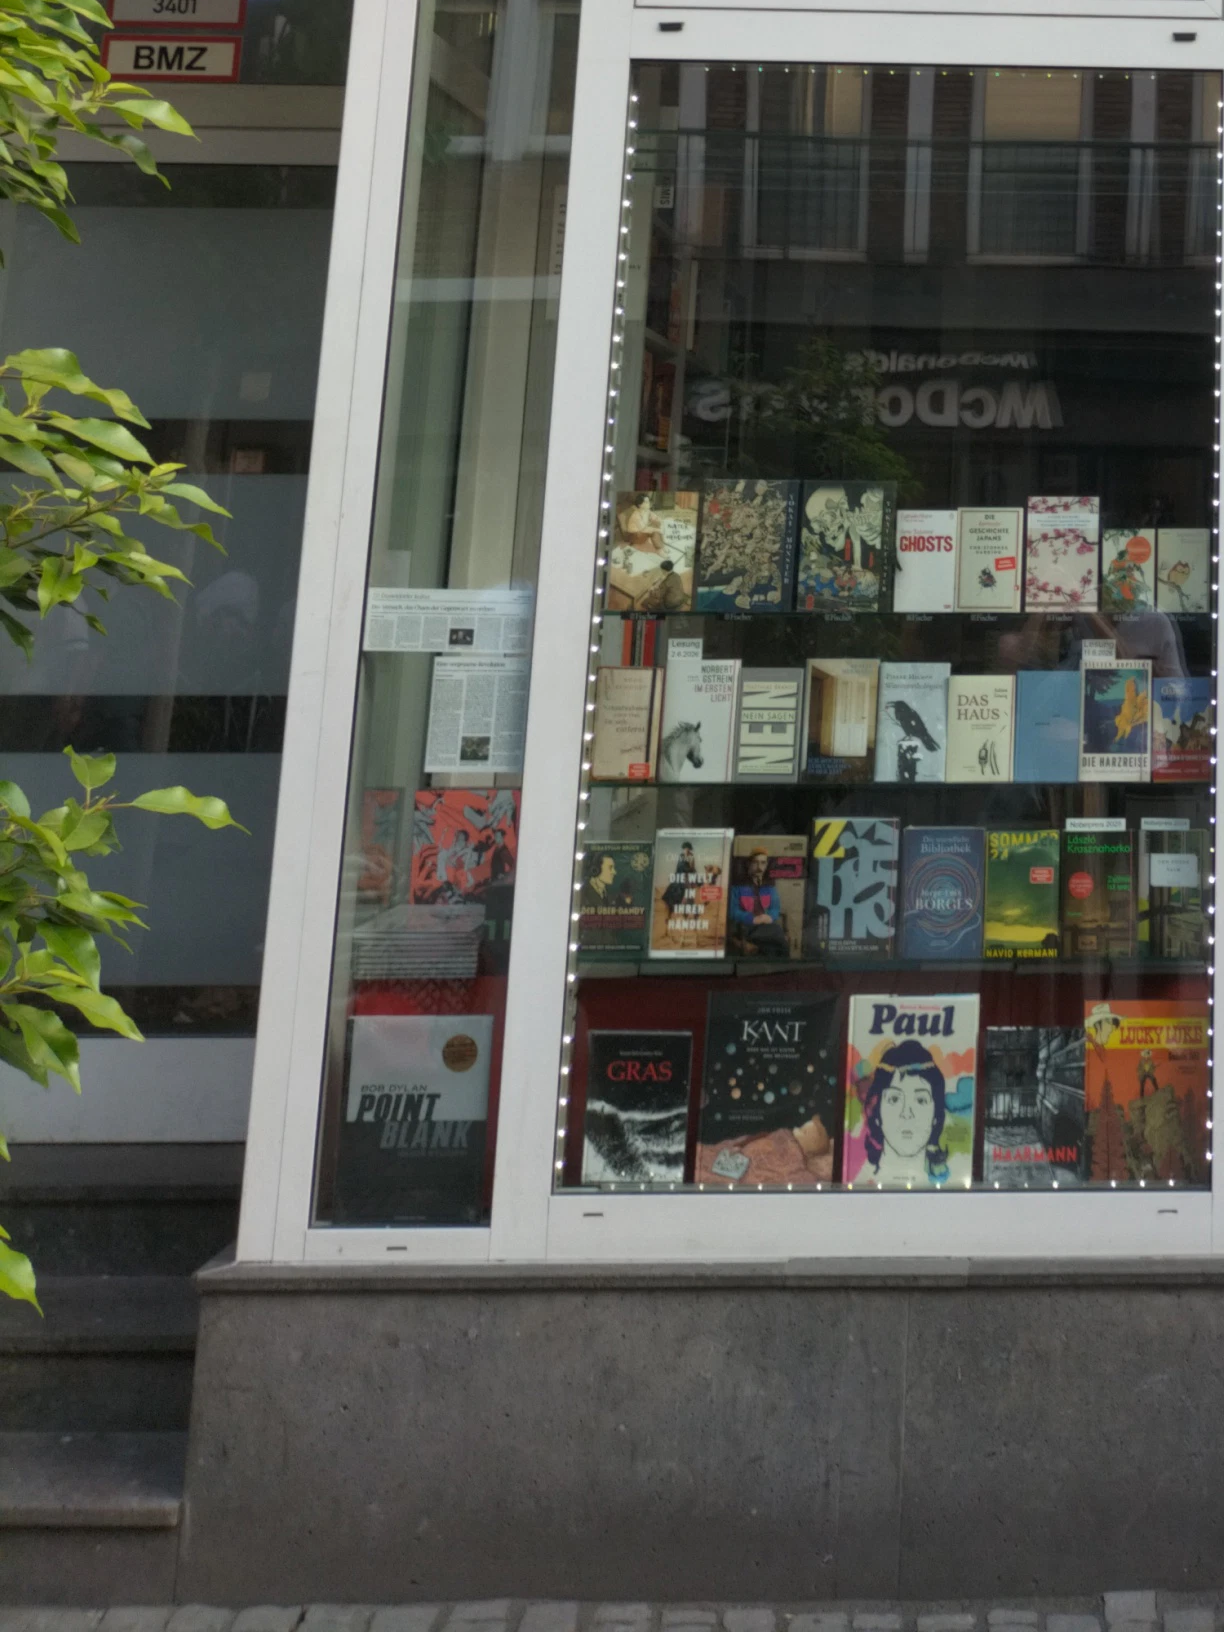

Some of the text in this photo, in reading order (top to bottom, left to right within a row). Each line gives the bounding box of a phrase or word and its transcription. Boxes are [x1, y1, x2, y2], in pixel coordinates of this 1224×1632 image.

[132, 44, 209, 72] BMZ
[899, 535, 953, 553] GHOSTS
[671, 640, 701, 649] Lesung
[1084, 640, 1115, 649] Lesung
[701, 665, 733, 674] NORBERT
[702, 675, 733, 684] GSTREIN
[694, 684, 732, 693] IM ERSTEN
[710, 694, 732, 703] LICHT
[957, 694, 989, 707] DAS
[742, 712, 795, 720] NEIN SAGEN
[957, 708, 1000, 721] HAUS
[1081, 757, 1096, 768] DIE
[1099, 756, 1148, 768] HARZREISE
[989, 832, 1059, 847] SOMMER
[1067, 834, 1096, 845] László
[920, 843, 972, 853] Bibliothek
[1067, 844, 1131, 853] Krasznahorka
[669, 873, 713, 883] DIE WELT
[685, 888, 696, 899] IN
[674, 904, 705, 914] IHREN
[915, 898, 974, 911] BORGES
[986, 948, 1058, 958] NAVID KERMANI
[868, 1003, 955, 1037] Paul
[740, 1019, 807, 1045] KANT
[1119, 1025, 1203, 1045] LUCKY LUKE
[606, 1060, 673, 1081] GRAS
[360, 1084, 428, 1092] BOB DYLAN
[354, 1092, 442, 1123] POINT
[379, 1120, 473, 1149] BLANK
[992, 1145, 1077, 1162] HAARMANN
